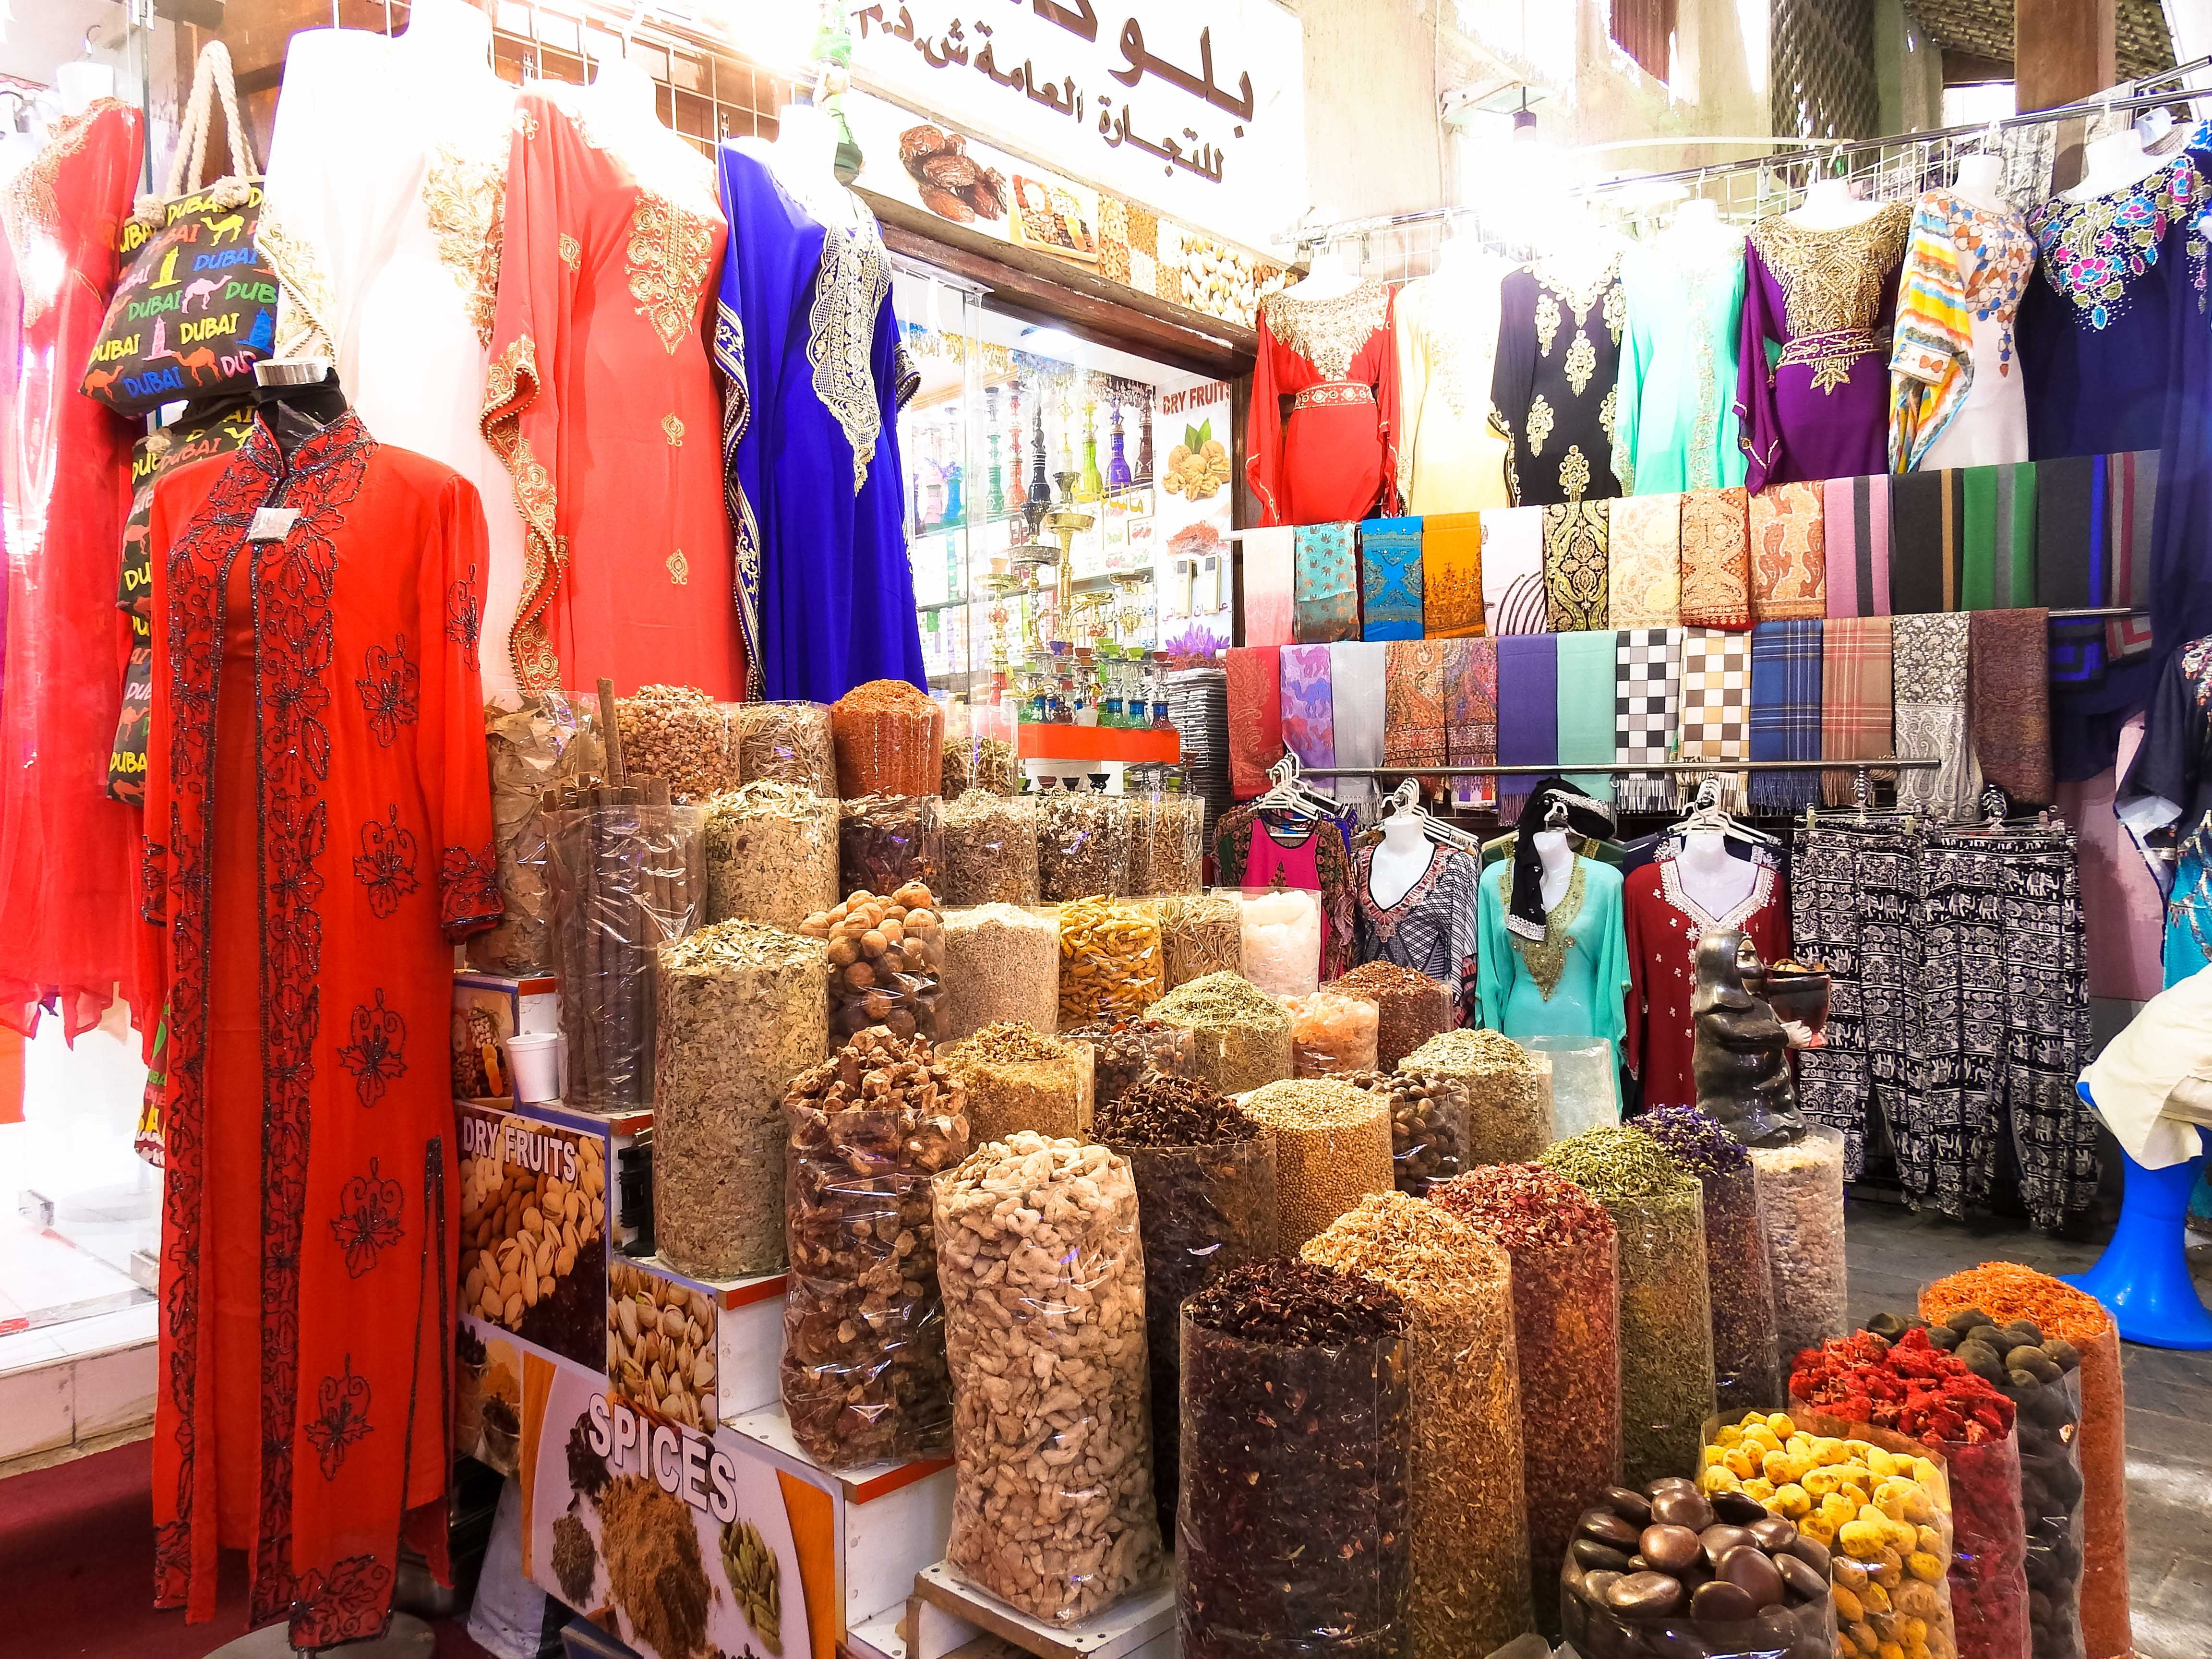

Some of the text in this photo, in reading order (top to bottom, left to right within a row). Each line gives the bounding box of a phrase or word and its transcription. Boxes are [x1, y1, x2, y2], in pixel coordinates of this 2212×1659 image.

[974, 20, 1083, 124] العامة
[1098, 95, 1224, 184] للتجارة
[167, 195, 227, 227] DUBA
[193, 247, 258, 272] DUBAI
[128, 289, 183, 322] DUBAI
[225, 281, 277, 303] DUB
[180, 312, 240, 345] DUBAI
[88, 333, 141, 365] DUBAI
[123, 366, 185, 398] DUBAI
[1163, 391, 1186, 415] DRY
[109, 751, 147, 773] DUBA
[463, 1117, 577, 1182] DRY FRUITS
[589, 1393, 738, 1524] SPICES
